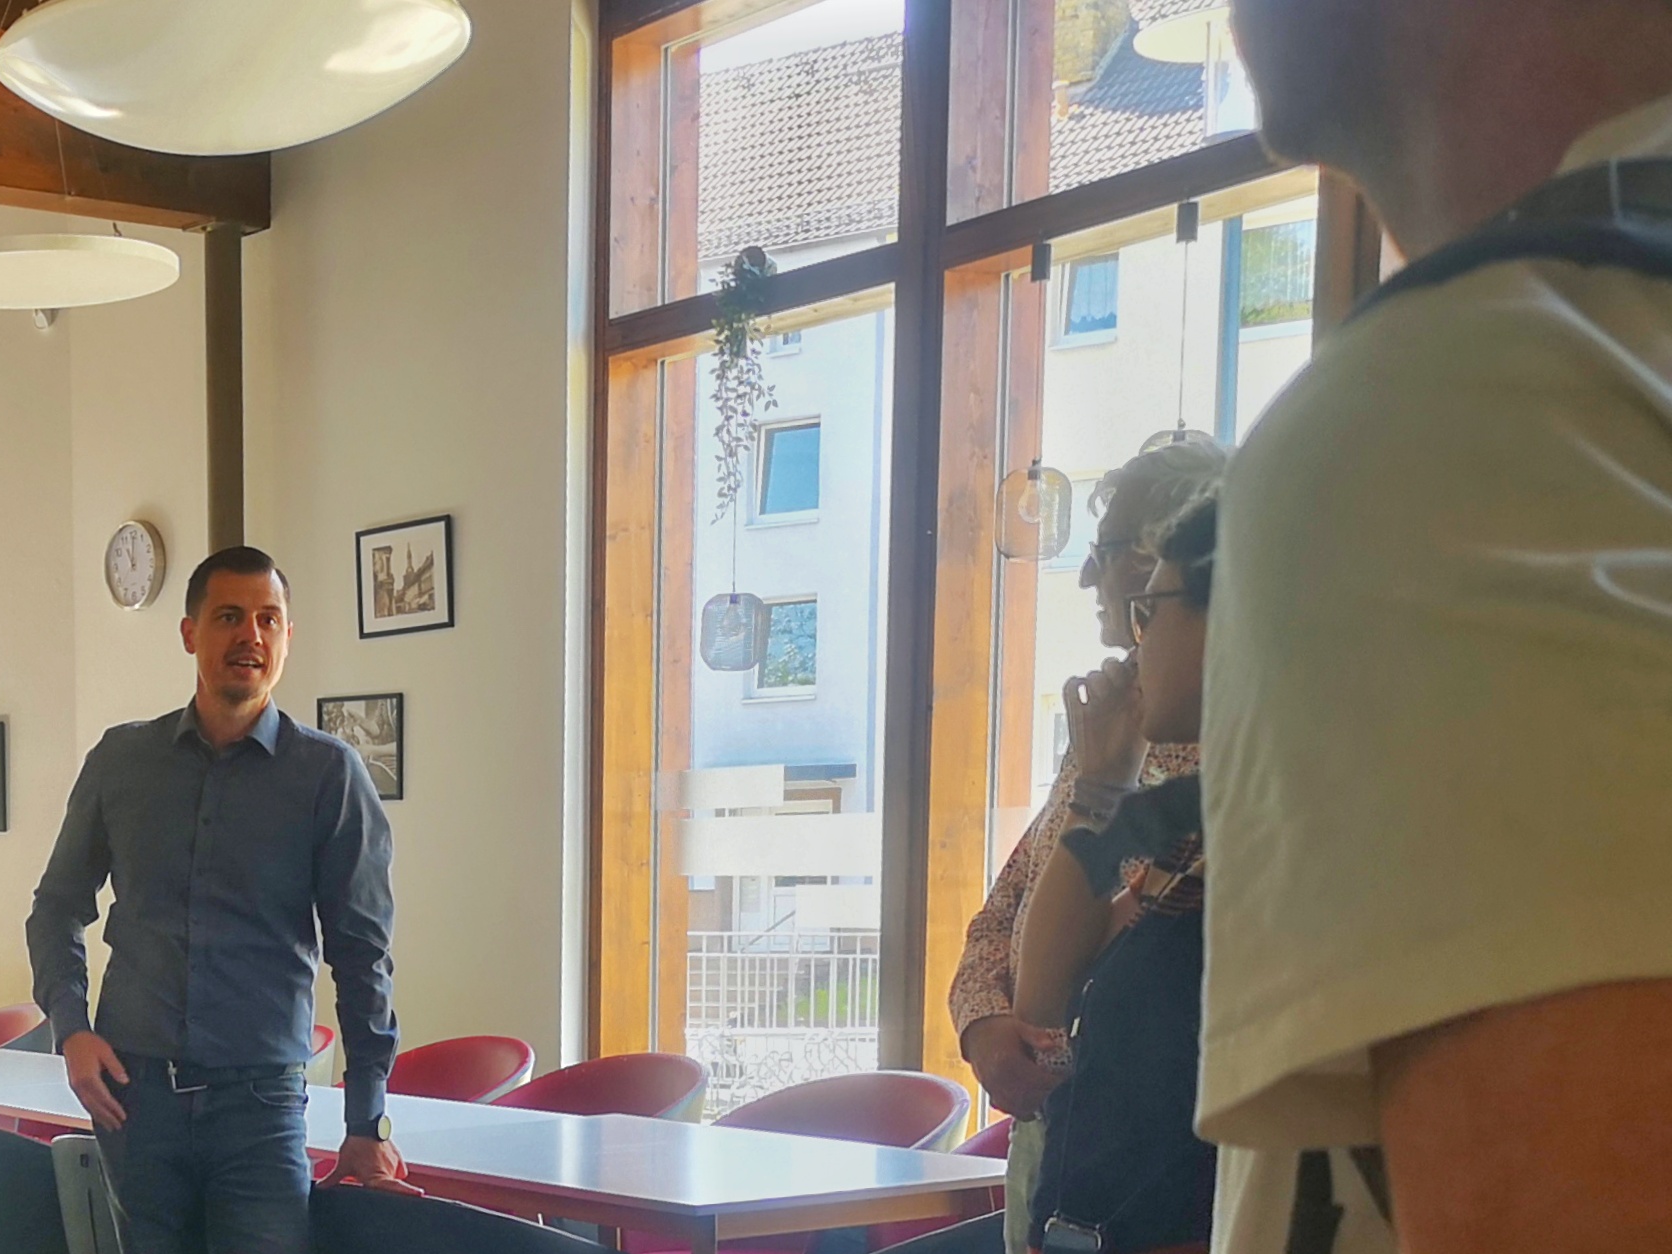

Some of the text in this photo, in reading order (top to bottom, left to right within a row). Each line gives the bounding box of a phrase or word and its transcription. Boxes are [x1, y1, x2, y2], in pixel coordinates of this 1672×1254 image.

[129, 529, 137, 540] 12
[121, 536, 128, 545] 11
[115, 548, 123, 557] 10
